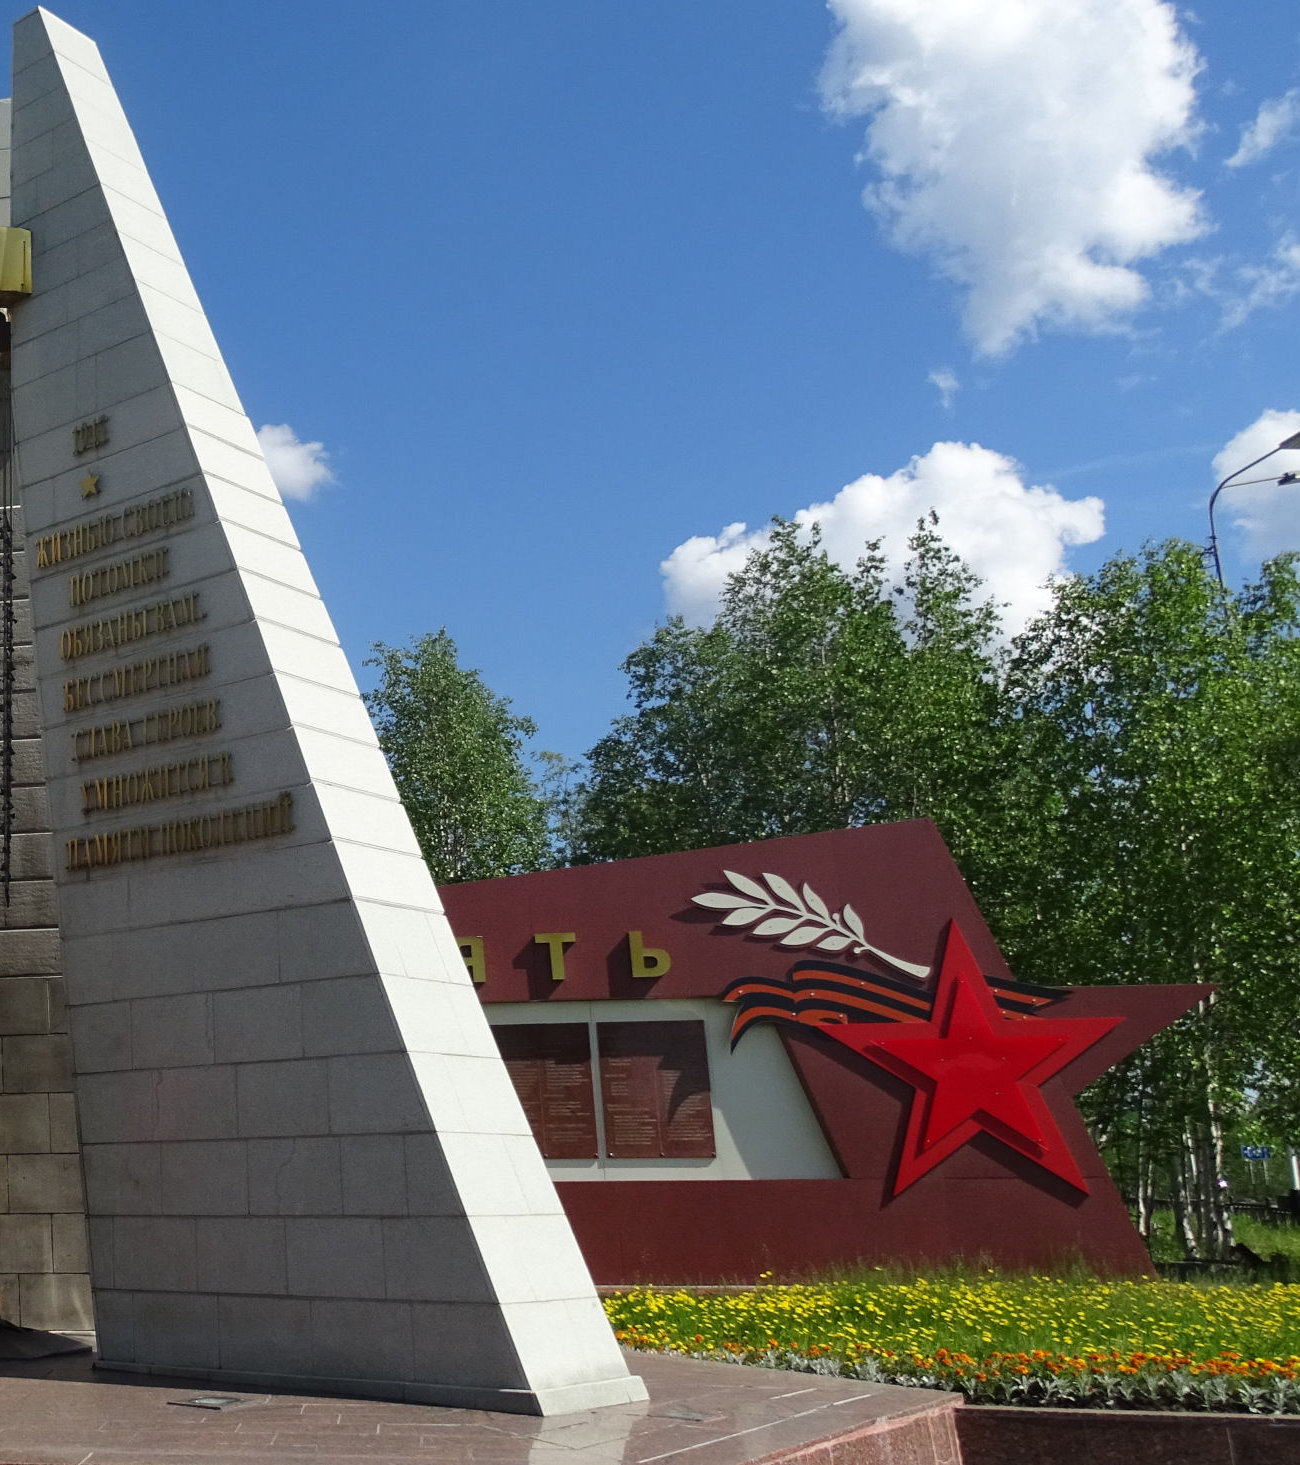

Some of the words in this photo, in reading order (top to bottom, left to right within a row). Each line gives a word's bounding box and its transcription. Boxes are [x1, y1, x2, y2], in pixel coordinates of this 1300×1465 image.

[35, 513, 114, 568] ЖИЗНЬЮ
[69, 547, 170, 607] ПОТОМКИ
[60, 609, 147, 661] ОБЯЗАНЫ
[63, 642, 211, 713] БЕССМЕРТНАЯ
[71, 716, 133, 761] СЛАВА
[141, 699, 222, 745] ГЕРОЕВ
[66, 825, 149, 872] ПАМЯТИ
[457, 930, 672, 982] ЯТЬ
